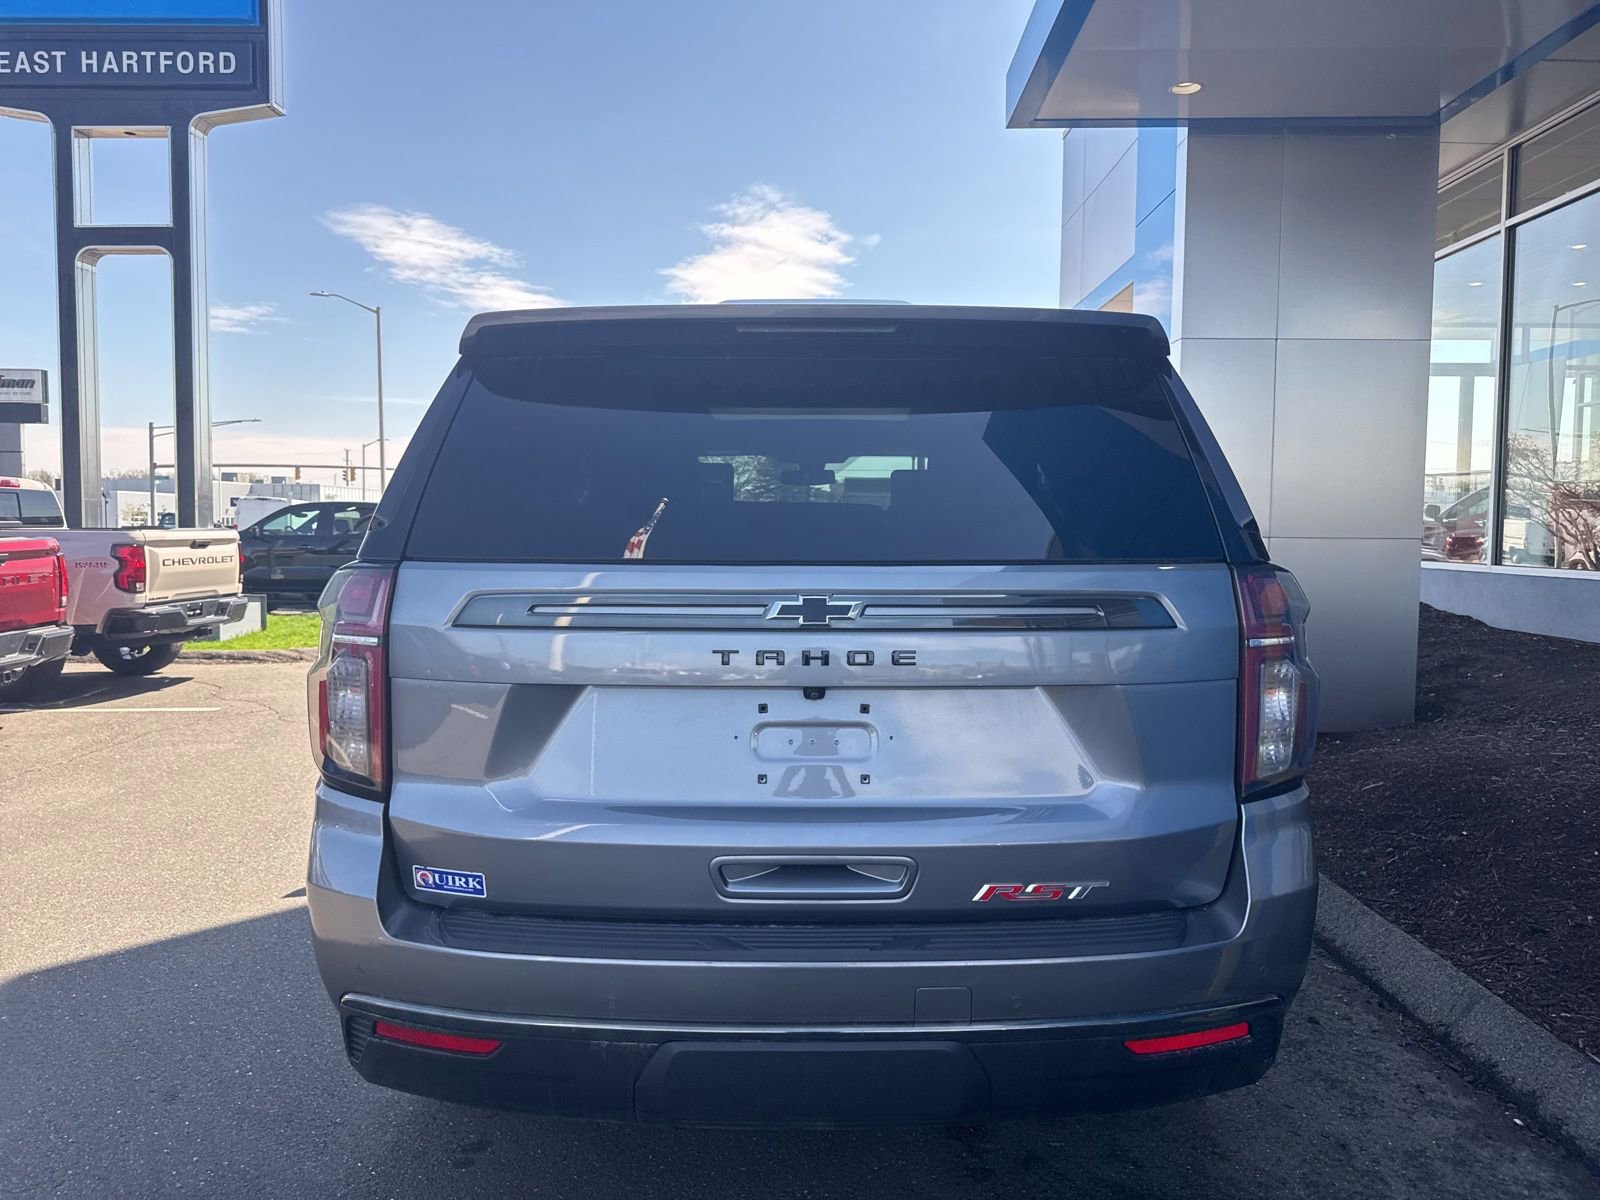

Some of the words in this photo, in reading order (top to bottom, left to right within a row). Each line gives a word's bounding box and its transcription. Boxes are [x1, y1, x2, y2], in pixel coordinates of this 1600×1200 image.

[0, 51, 66, 74] EAST
[81, 51, 236, 74] HARTFORD
[162, 555, 234, 567] CHEVROLET
[712, 649, 917, 666] TAHOE
[416, 870, 483, 890] QUIRK
[972, 880, 1110, 902] RST
